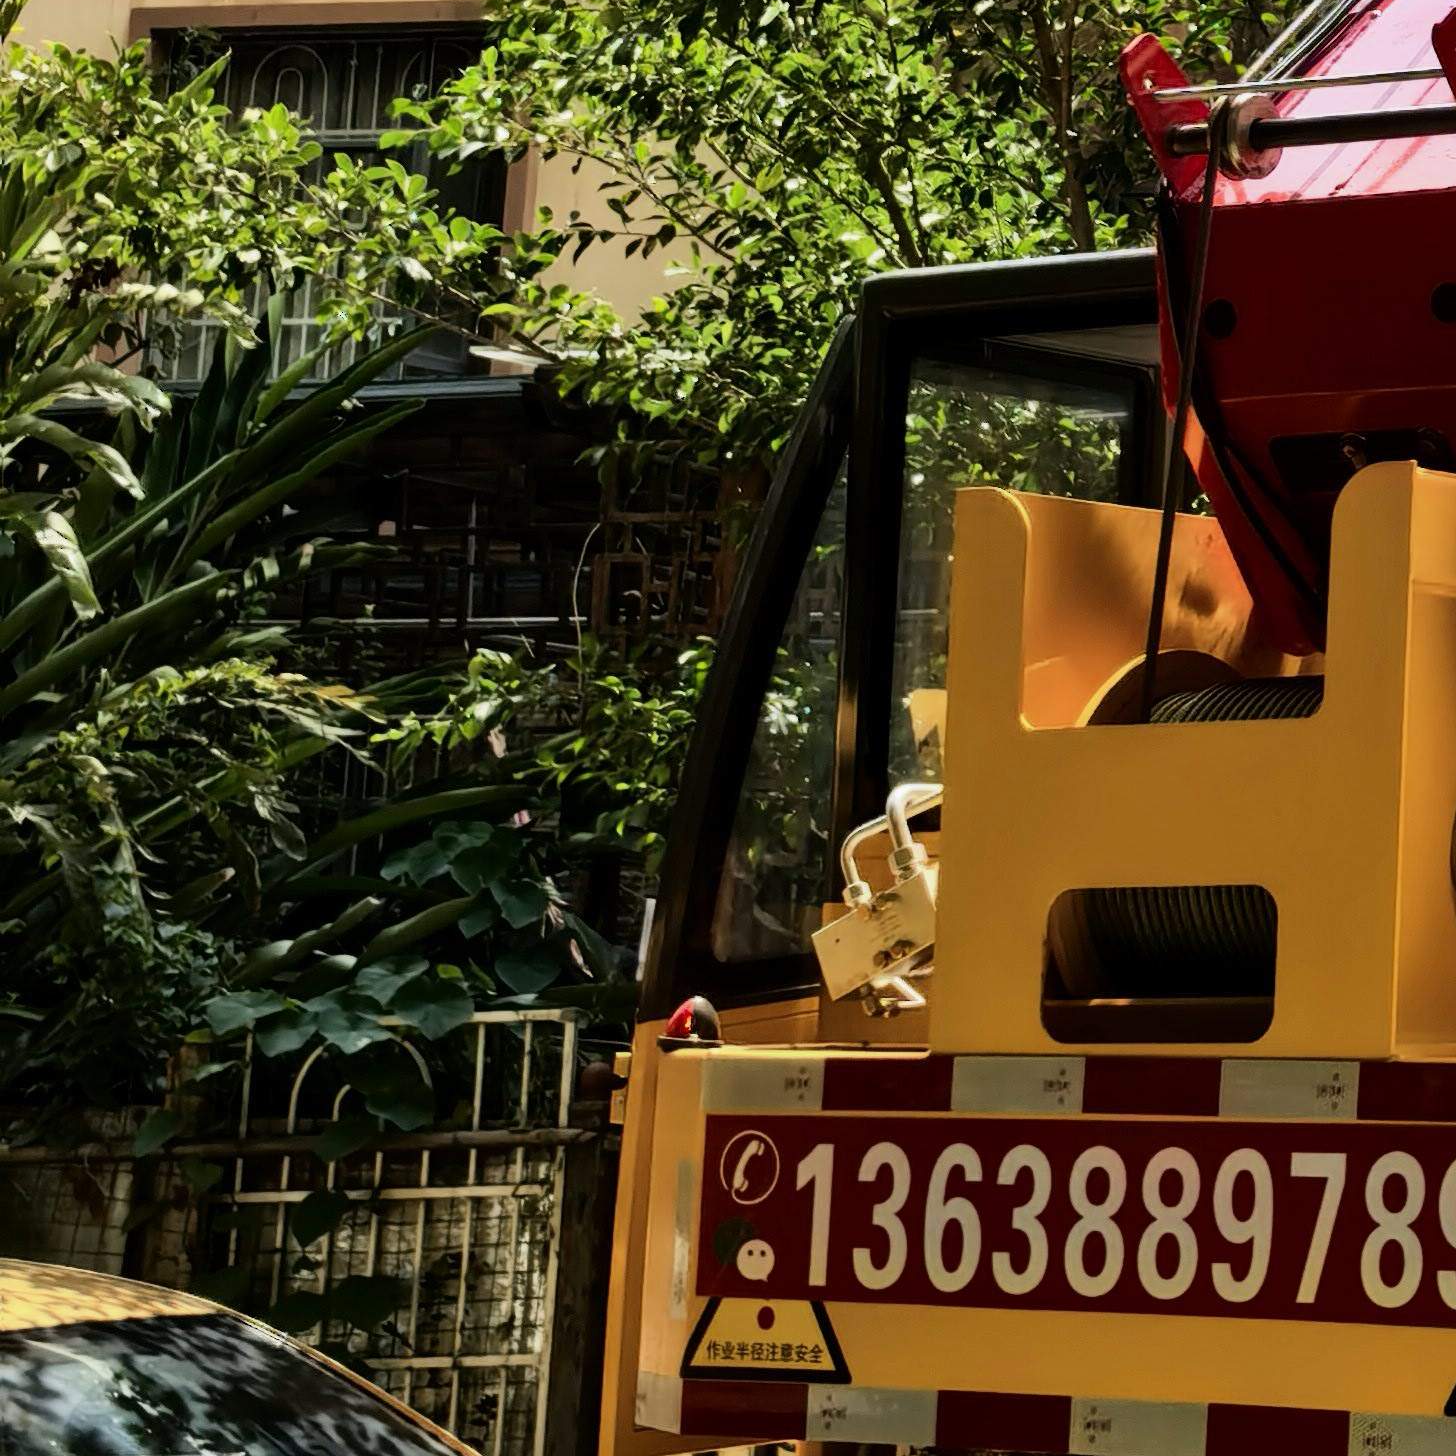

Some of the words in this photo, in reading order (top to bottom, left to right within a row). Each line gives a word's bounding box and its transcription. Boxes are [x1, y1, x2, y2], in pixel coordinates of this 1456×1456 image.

[706, 1339, 824, 1364] 作业半径注意安全
